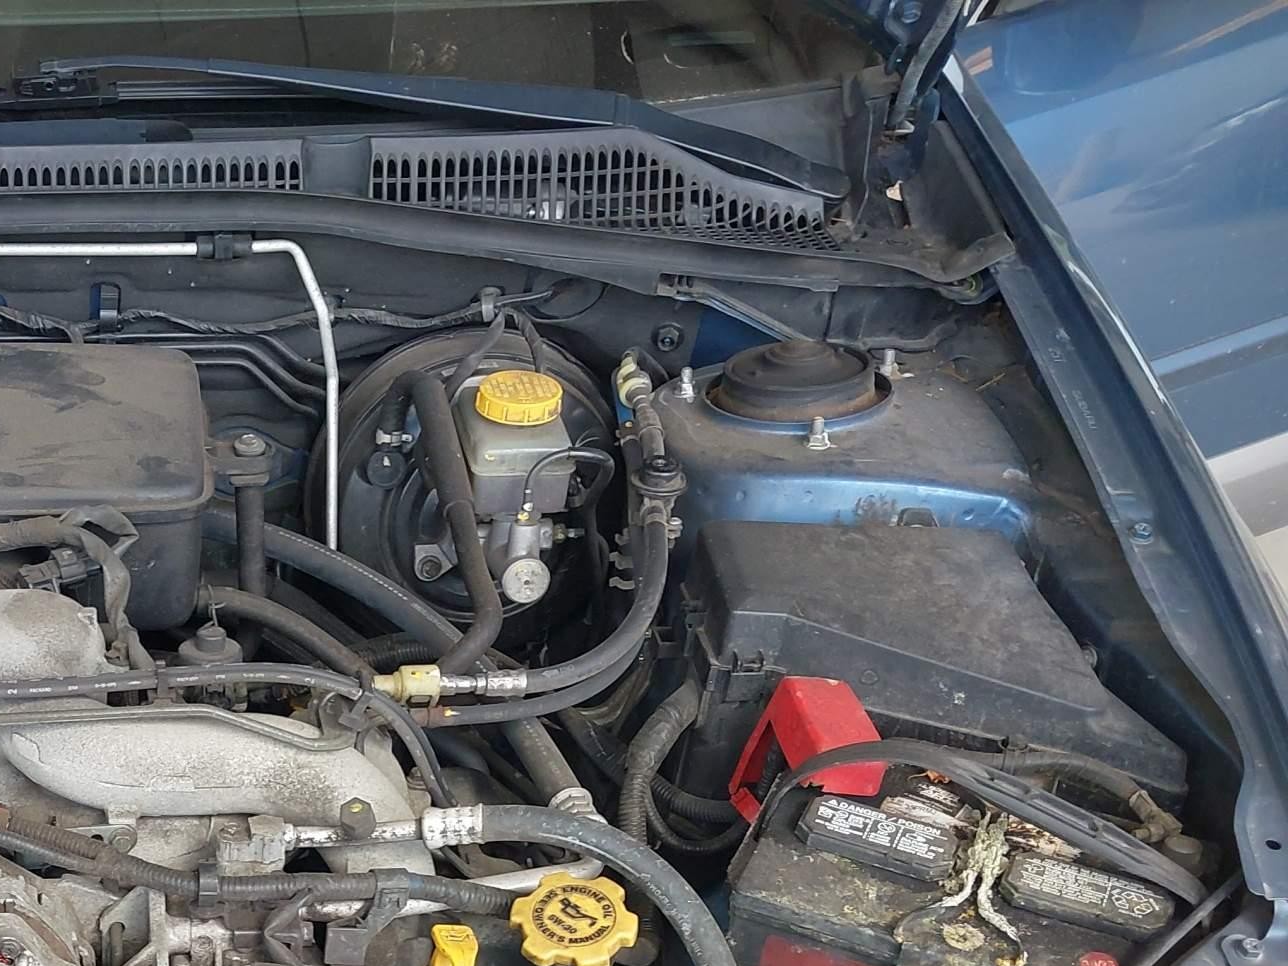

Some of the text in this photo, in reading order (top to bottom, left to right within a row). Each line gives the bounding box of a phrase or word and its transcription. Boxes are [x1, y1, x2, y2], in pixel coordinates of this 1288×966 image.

[838, 801, 887, 820] DANGER
[899, 817, 941, 837] POISON
[562, 886, 605, 904] ENGINE
[602, 903, 613, 919] OIL
[535, 907, 611, 945] OWNER'S MANUAL
